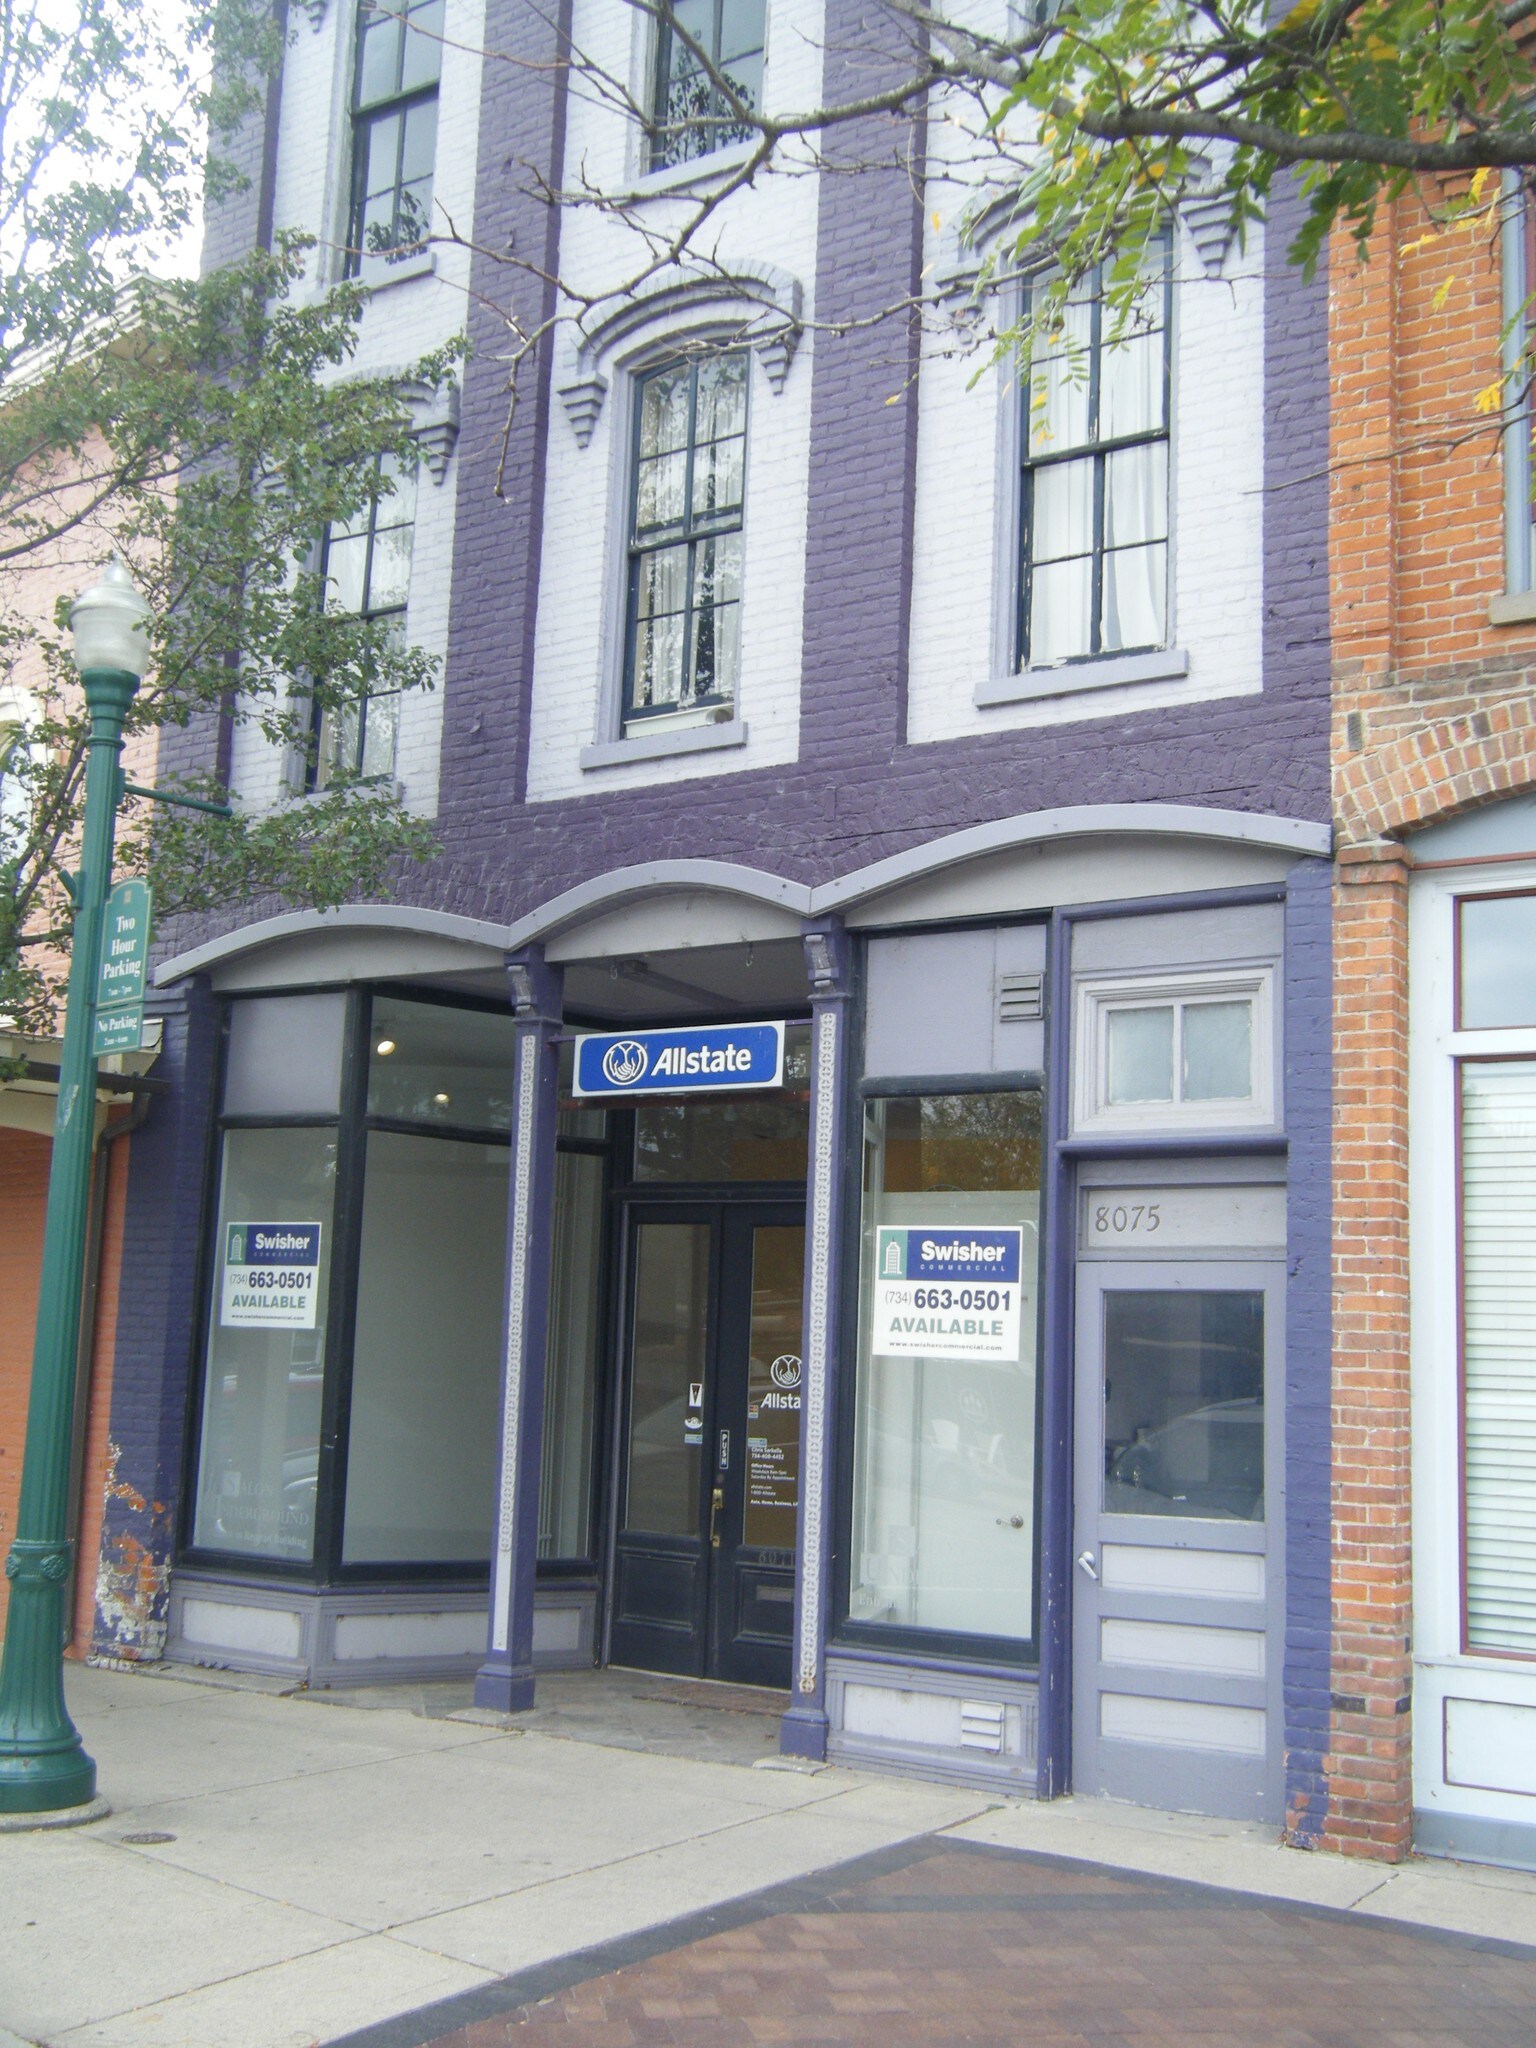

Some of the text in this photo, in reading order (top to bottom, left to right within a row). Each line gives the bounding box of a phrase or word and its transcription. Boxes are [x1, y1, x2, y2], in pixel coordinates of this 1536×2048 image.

[116, 915, 136, 933] Two
[111, 938, 137, 957] Hour
[103, 959, 142, 980] Parking
[98, 1016, 138, 1032] No Parking
[650, 1043, 752, 1077] Allstate
[1095, 1204, 1161, 1233] 8075
[255, 1232, 311, 1250] Swisher
[921, 1240, 1006, 1263] Swisher
[919, 1264, 1006, 1272] COMMERCIAL
[229, 1271, 312, 1289] (734) 663-0501
[231, 1294, 306, 1309] AVAILABLE
[884, 1288, 1011, 1311] (734) 663-0501
[888, 1316, 1004, 1336] AVAILABLE
[888, 1341, 1003, 1352] www.swishercommercial.com
[760, 1392, 801, 1410] Allsta
